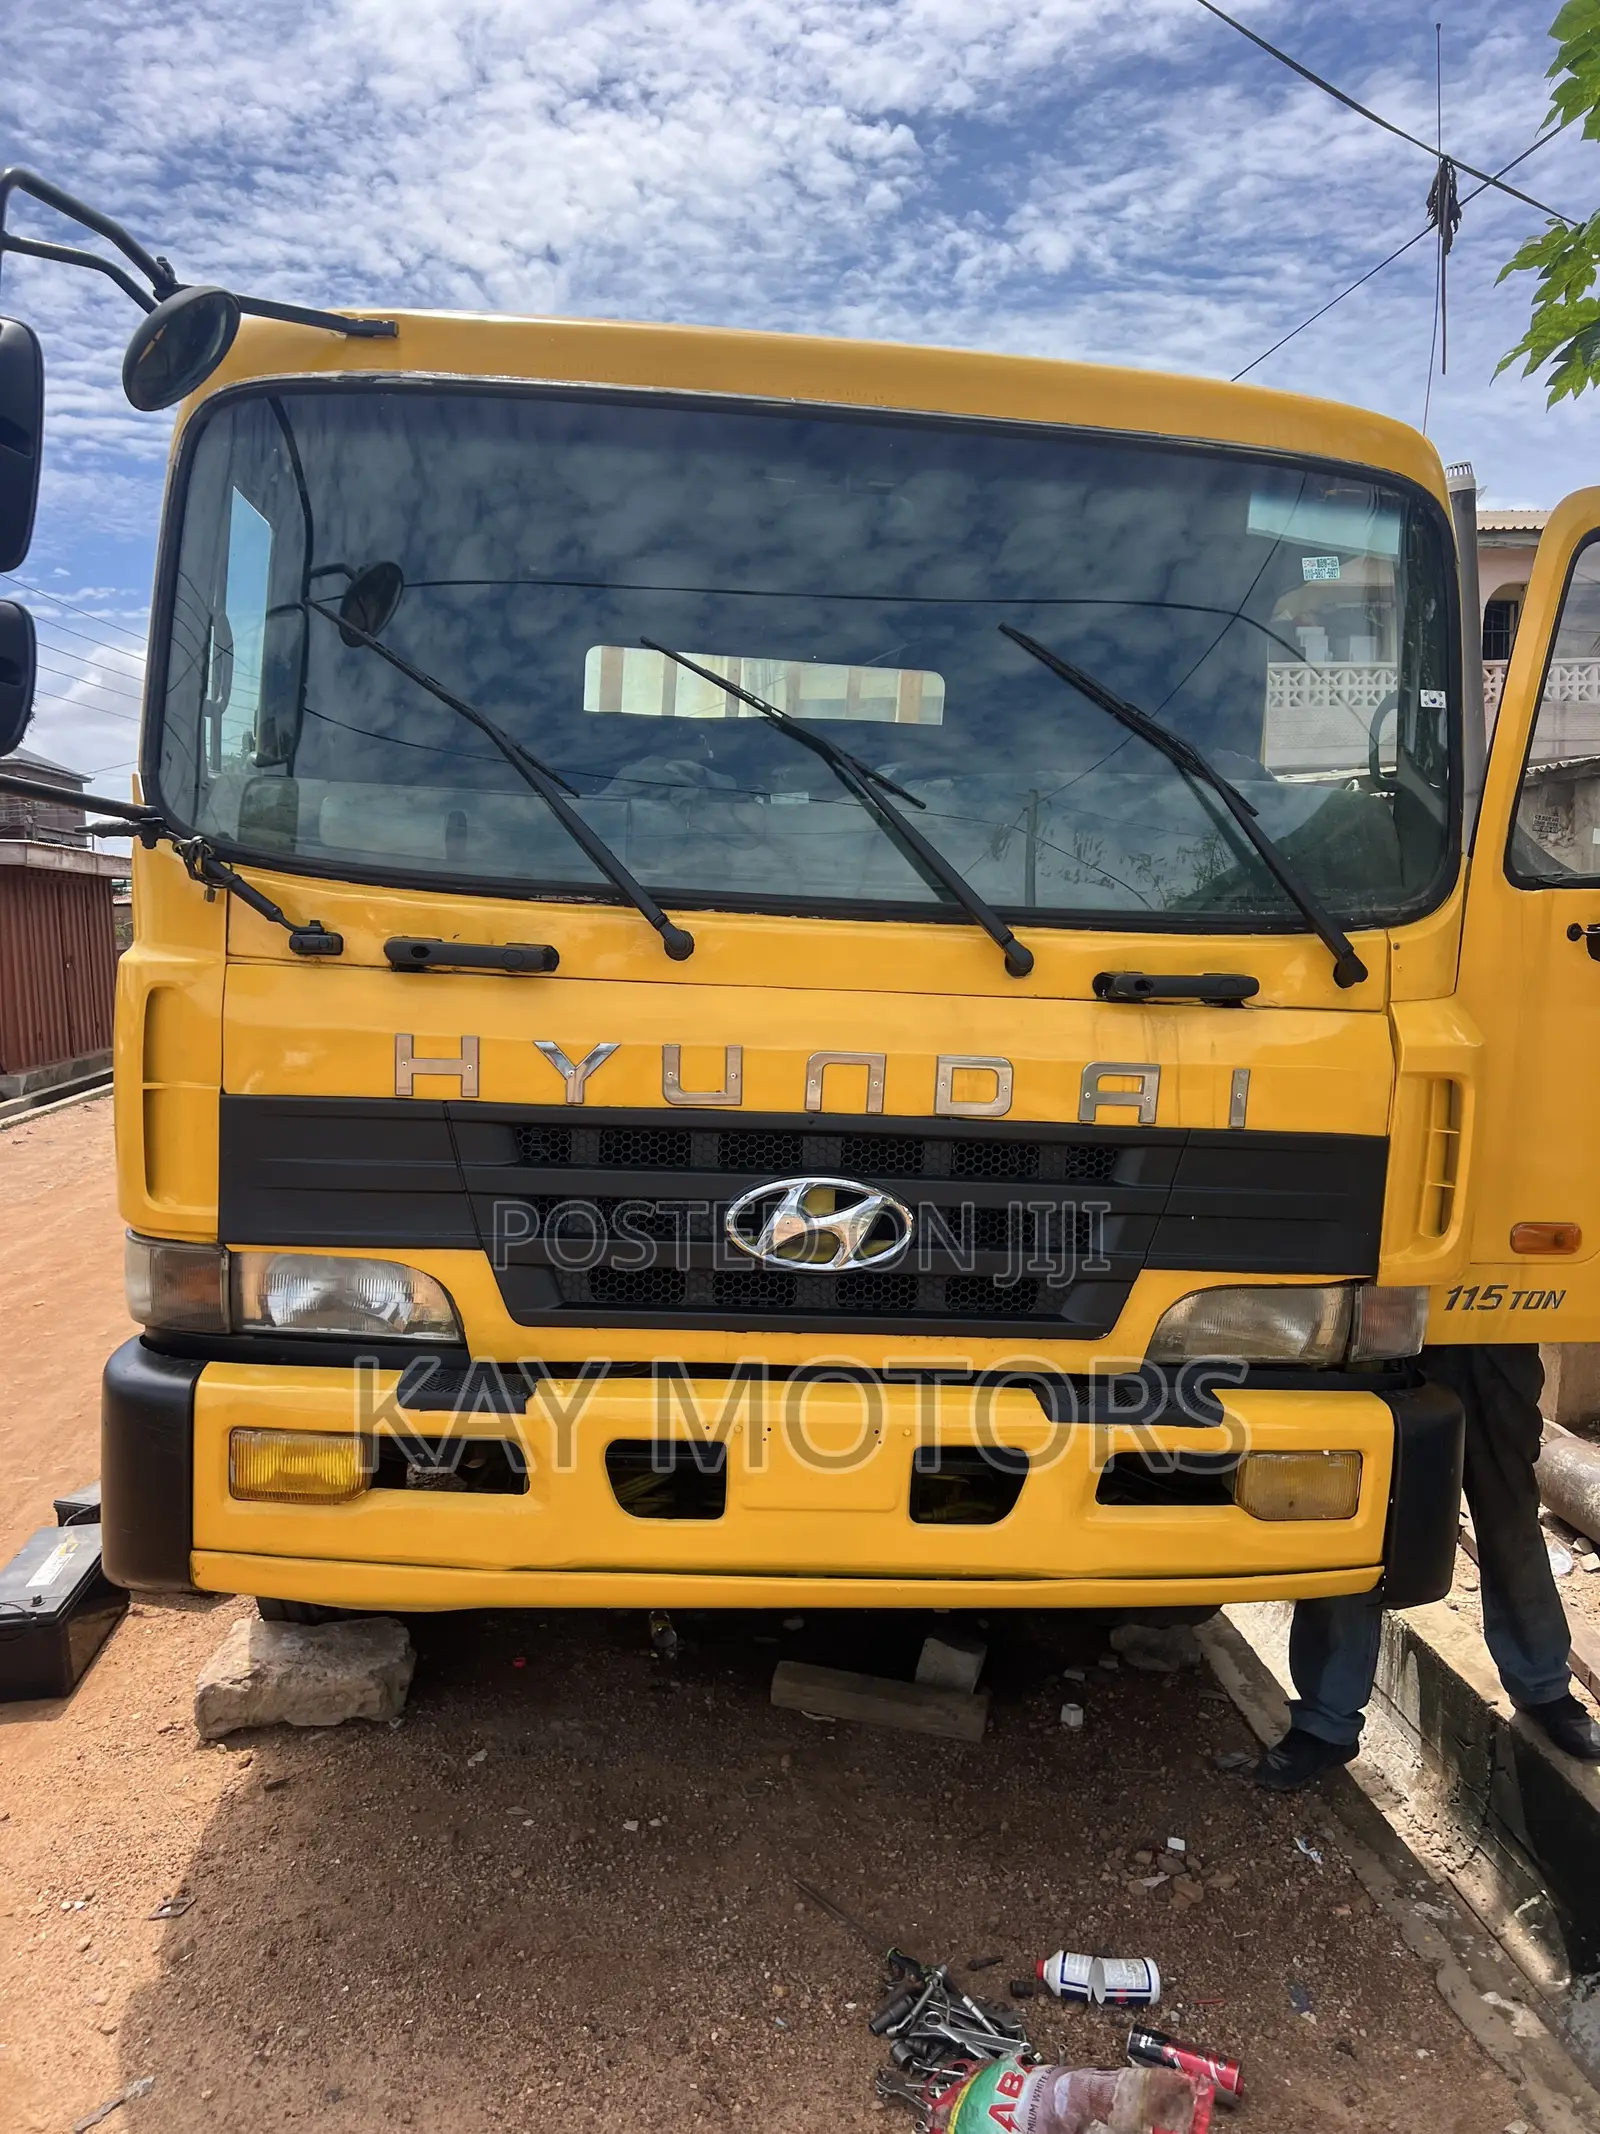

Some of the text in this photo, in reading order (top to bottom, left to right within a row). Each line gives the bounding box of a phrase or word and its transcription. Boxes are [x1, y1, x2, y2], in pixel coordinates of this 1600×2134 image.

[394, 1033, 1251, 1128] HYUNDAI
[1508, 1289, 1567, 1310] TON
[1032, 2075, 1049, 2102] WHITE
